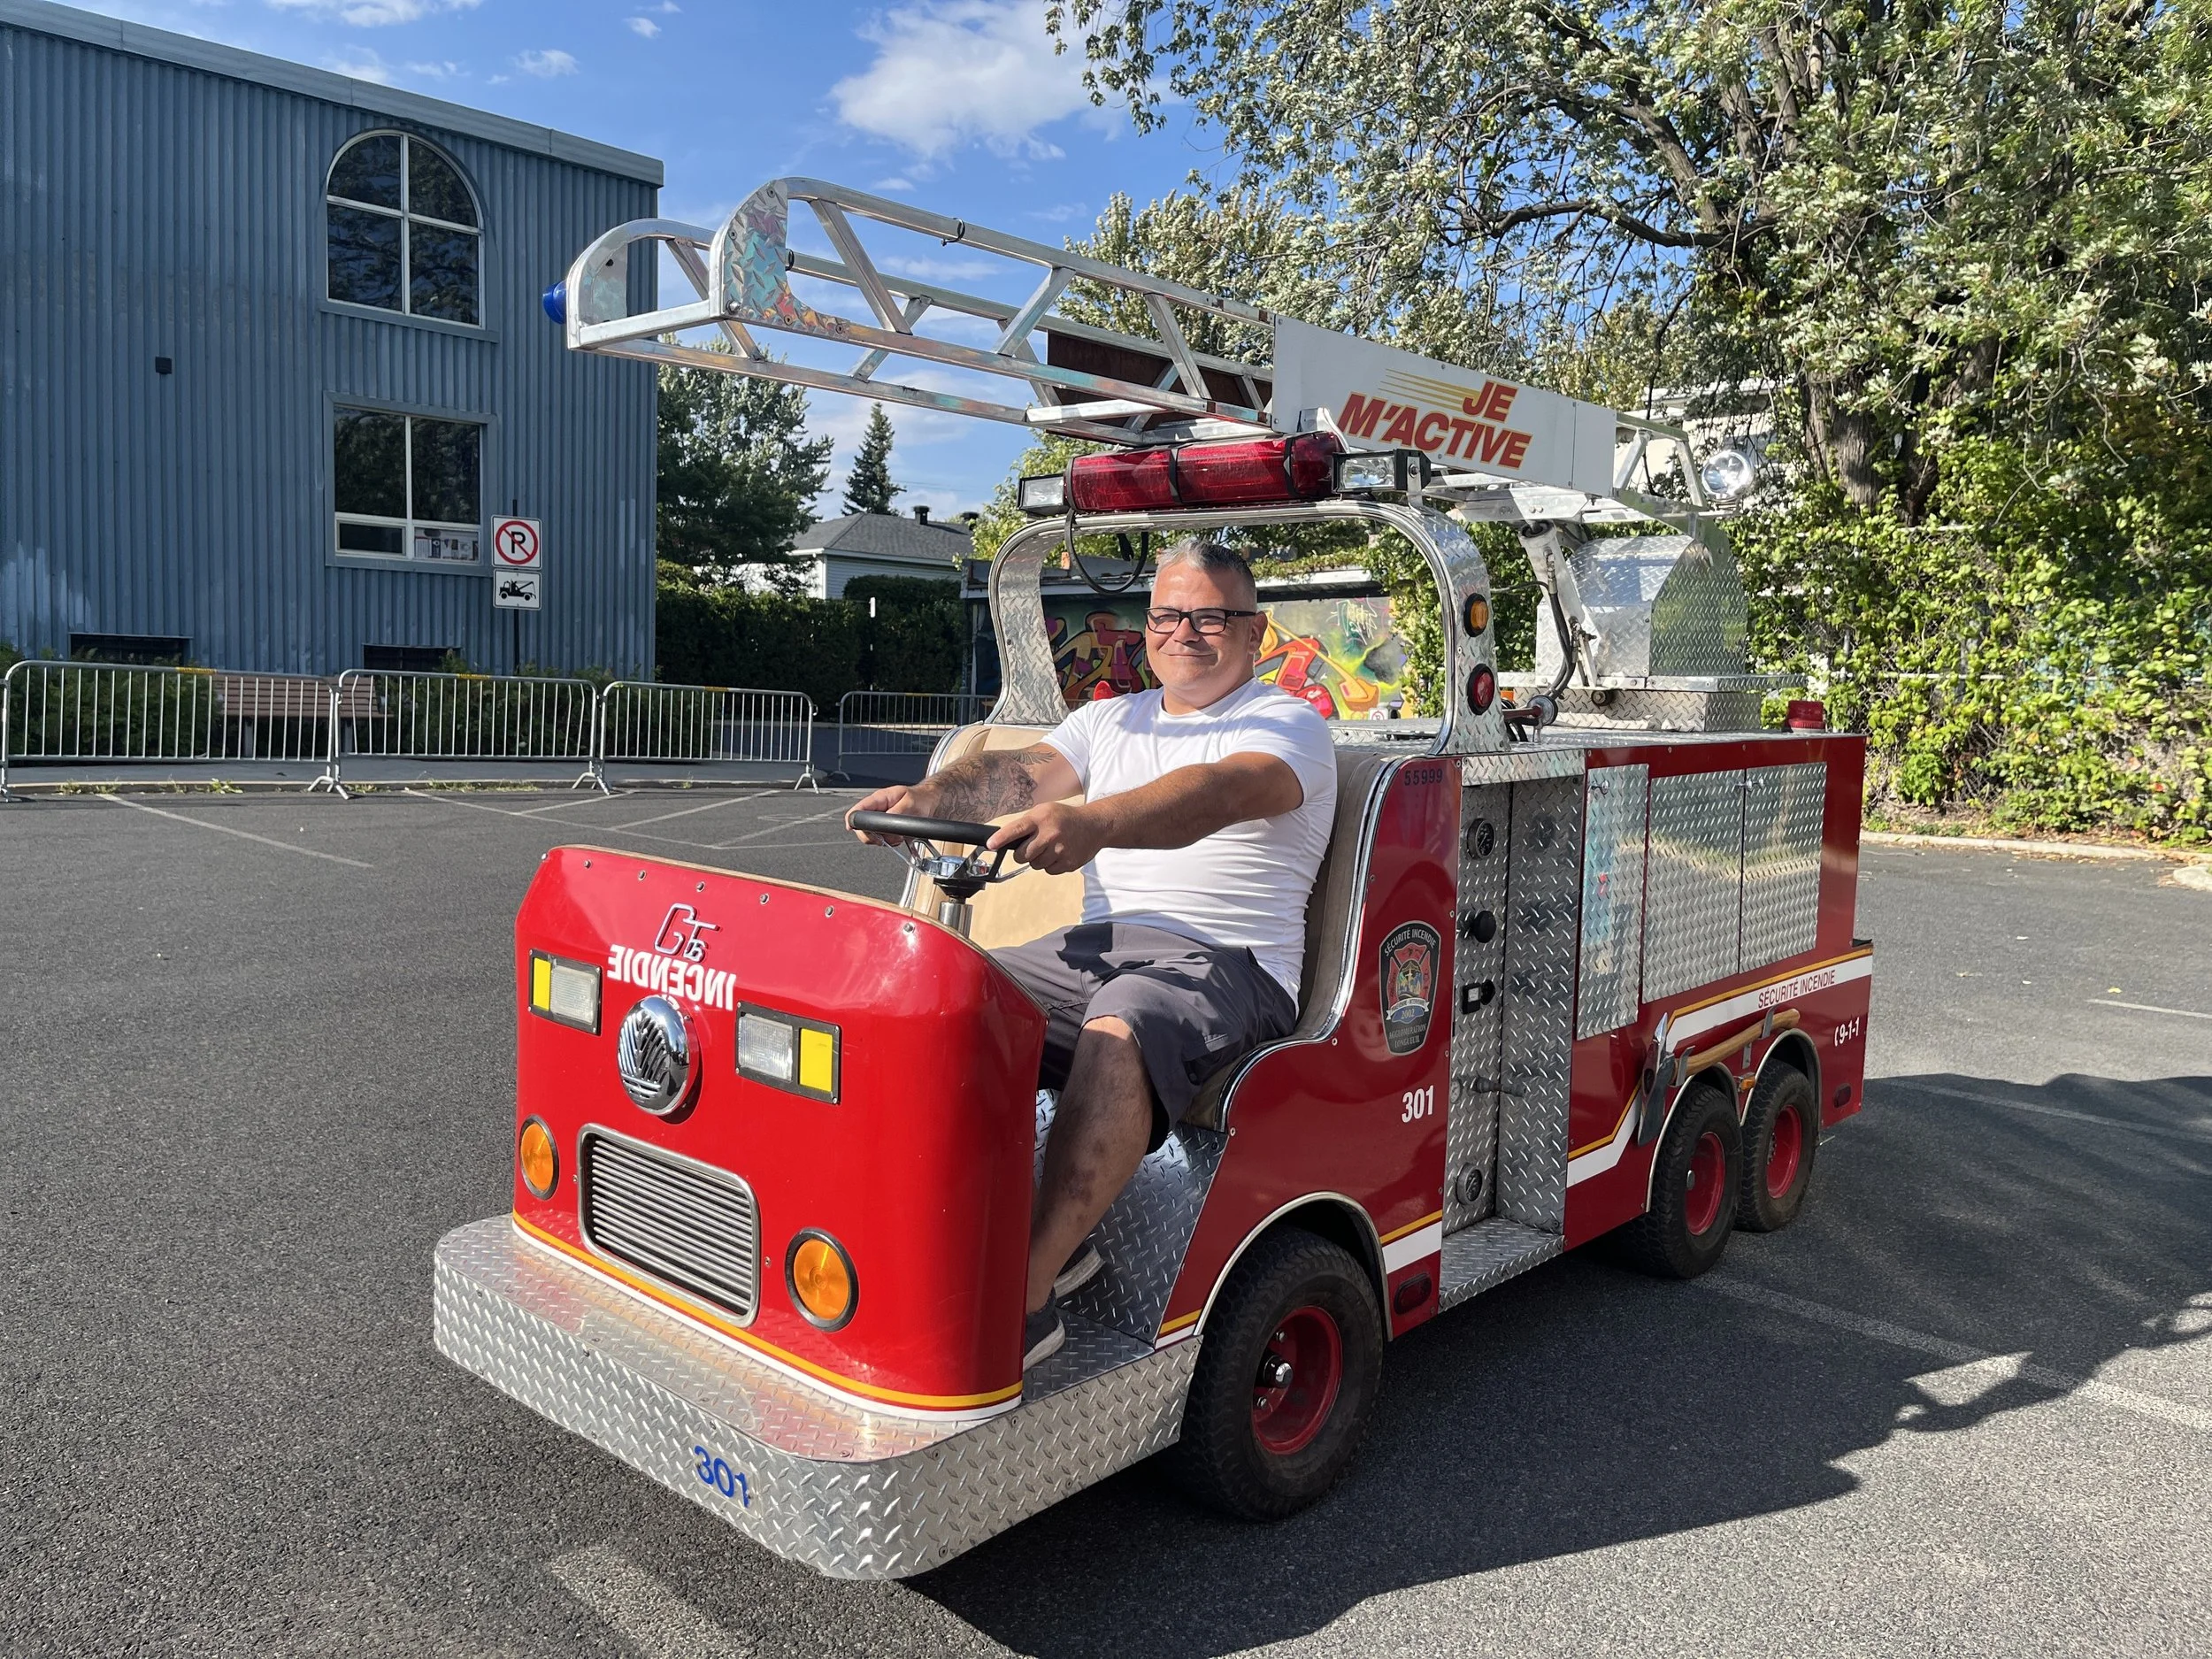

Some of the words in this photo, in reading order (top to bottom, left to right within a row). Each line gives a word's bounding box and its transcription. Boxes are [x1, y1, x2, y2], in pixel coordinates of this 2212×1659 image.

[1462, 380, 1518, 422] JE
[1336, 391, 1533, 470] M'ACTIVE
[511, 531, 526, 554] P
[1404, 768, 1443, 786] 55999
[1385, 927, 1411, 956] SÉCURITÉ
[1411, 928, 1436, 949] INCENDIE
[1758, 979, 1799, 1009] SÉCURITÉ
[1800, 969, 1836, 995] INCENDIE
[1402, 1085, 1433, 1123] 301
[694, 1445, 750, 1509] 301
